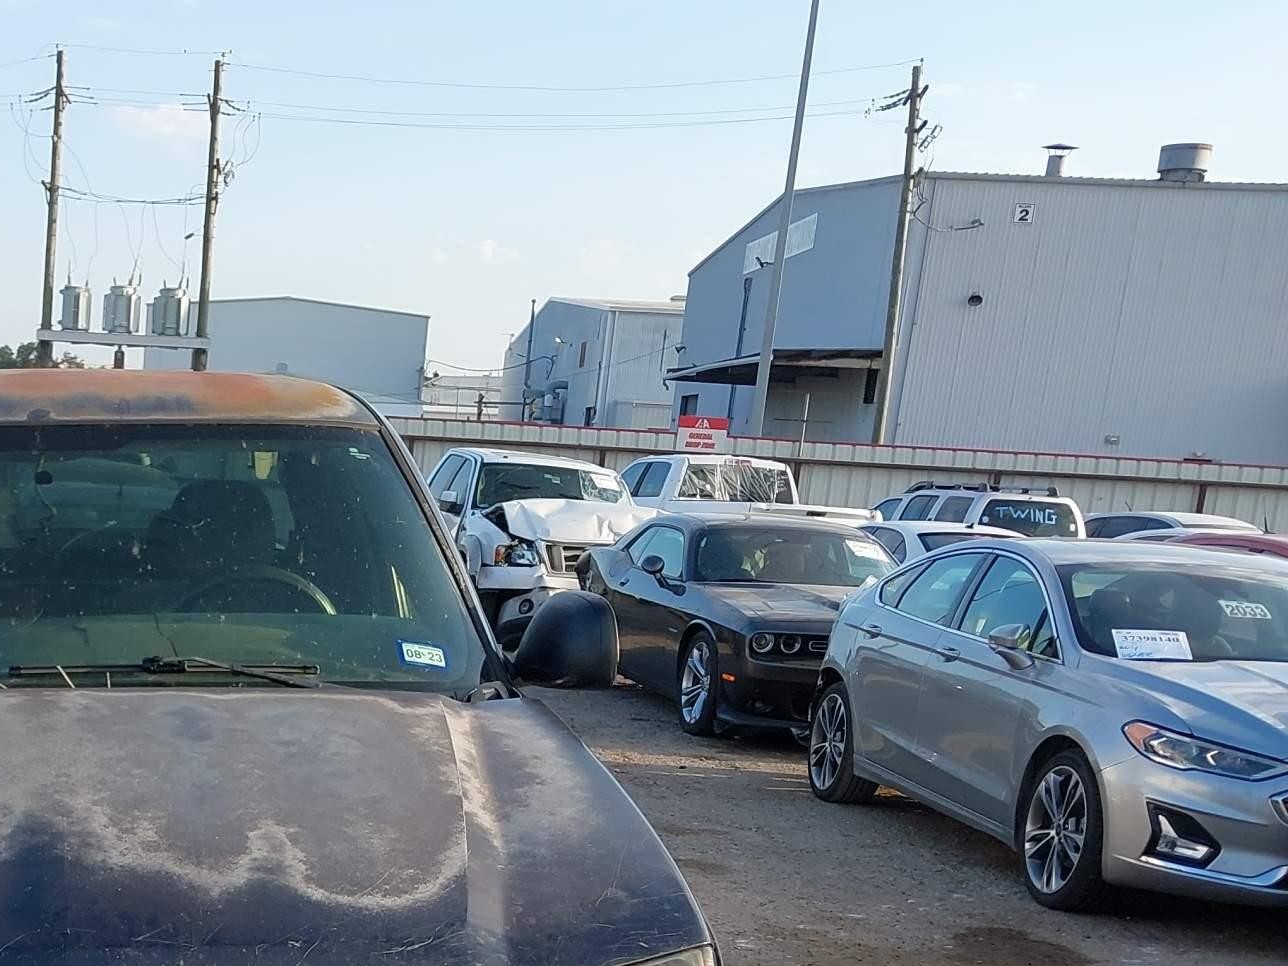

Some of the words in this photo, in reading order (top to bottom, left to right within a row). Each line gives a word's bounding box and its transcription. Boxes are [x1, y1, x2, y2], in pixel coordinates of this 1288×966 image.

[1018, 209, 1029, 221] 2
[994, 505, 1058, 525] TWING
[1224, 603, 1269, 619] 2033
[406, 648, 422, 659] 08
[427, 652, 443, 663] 23
